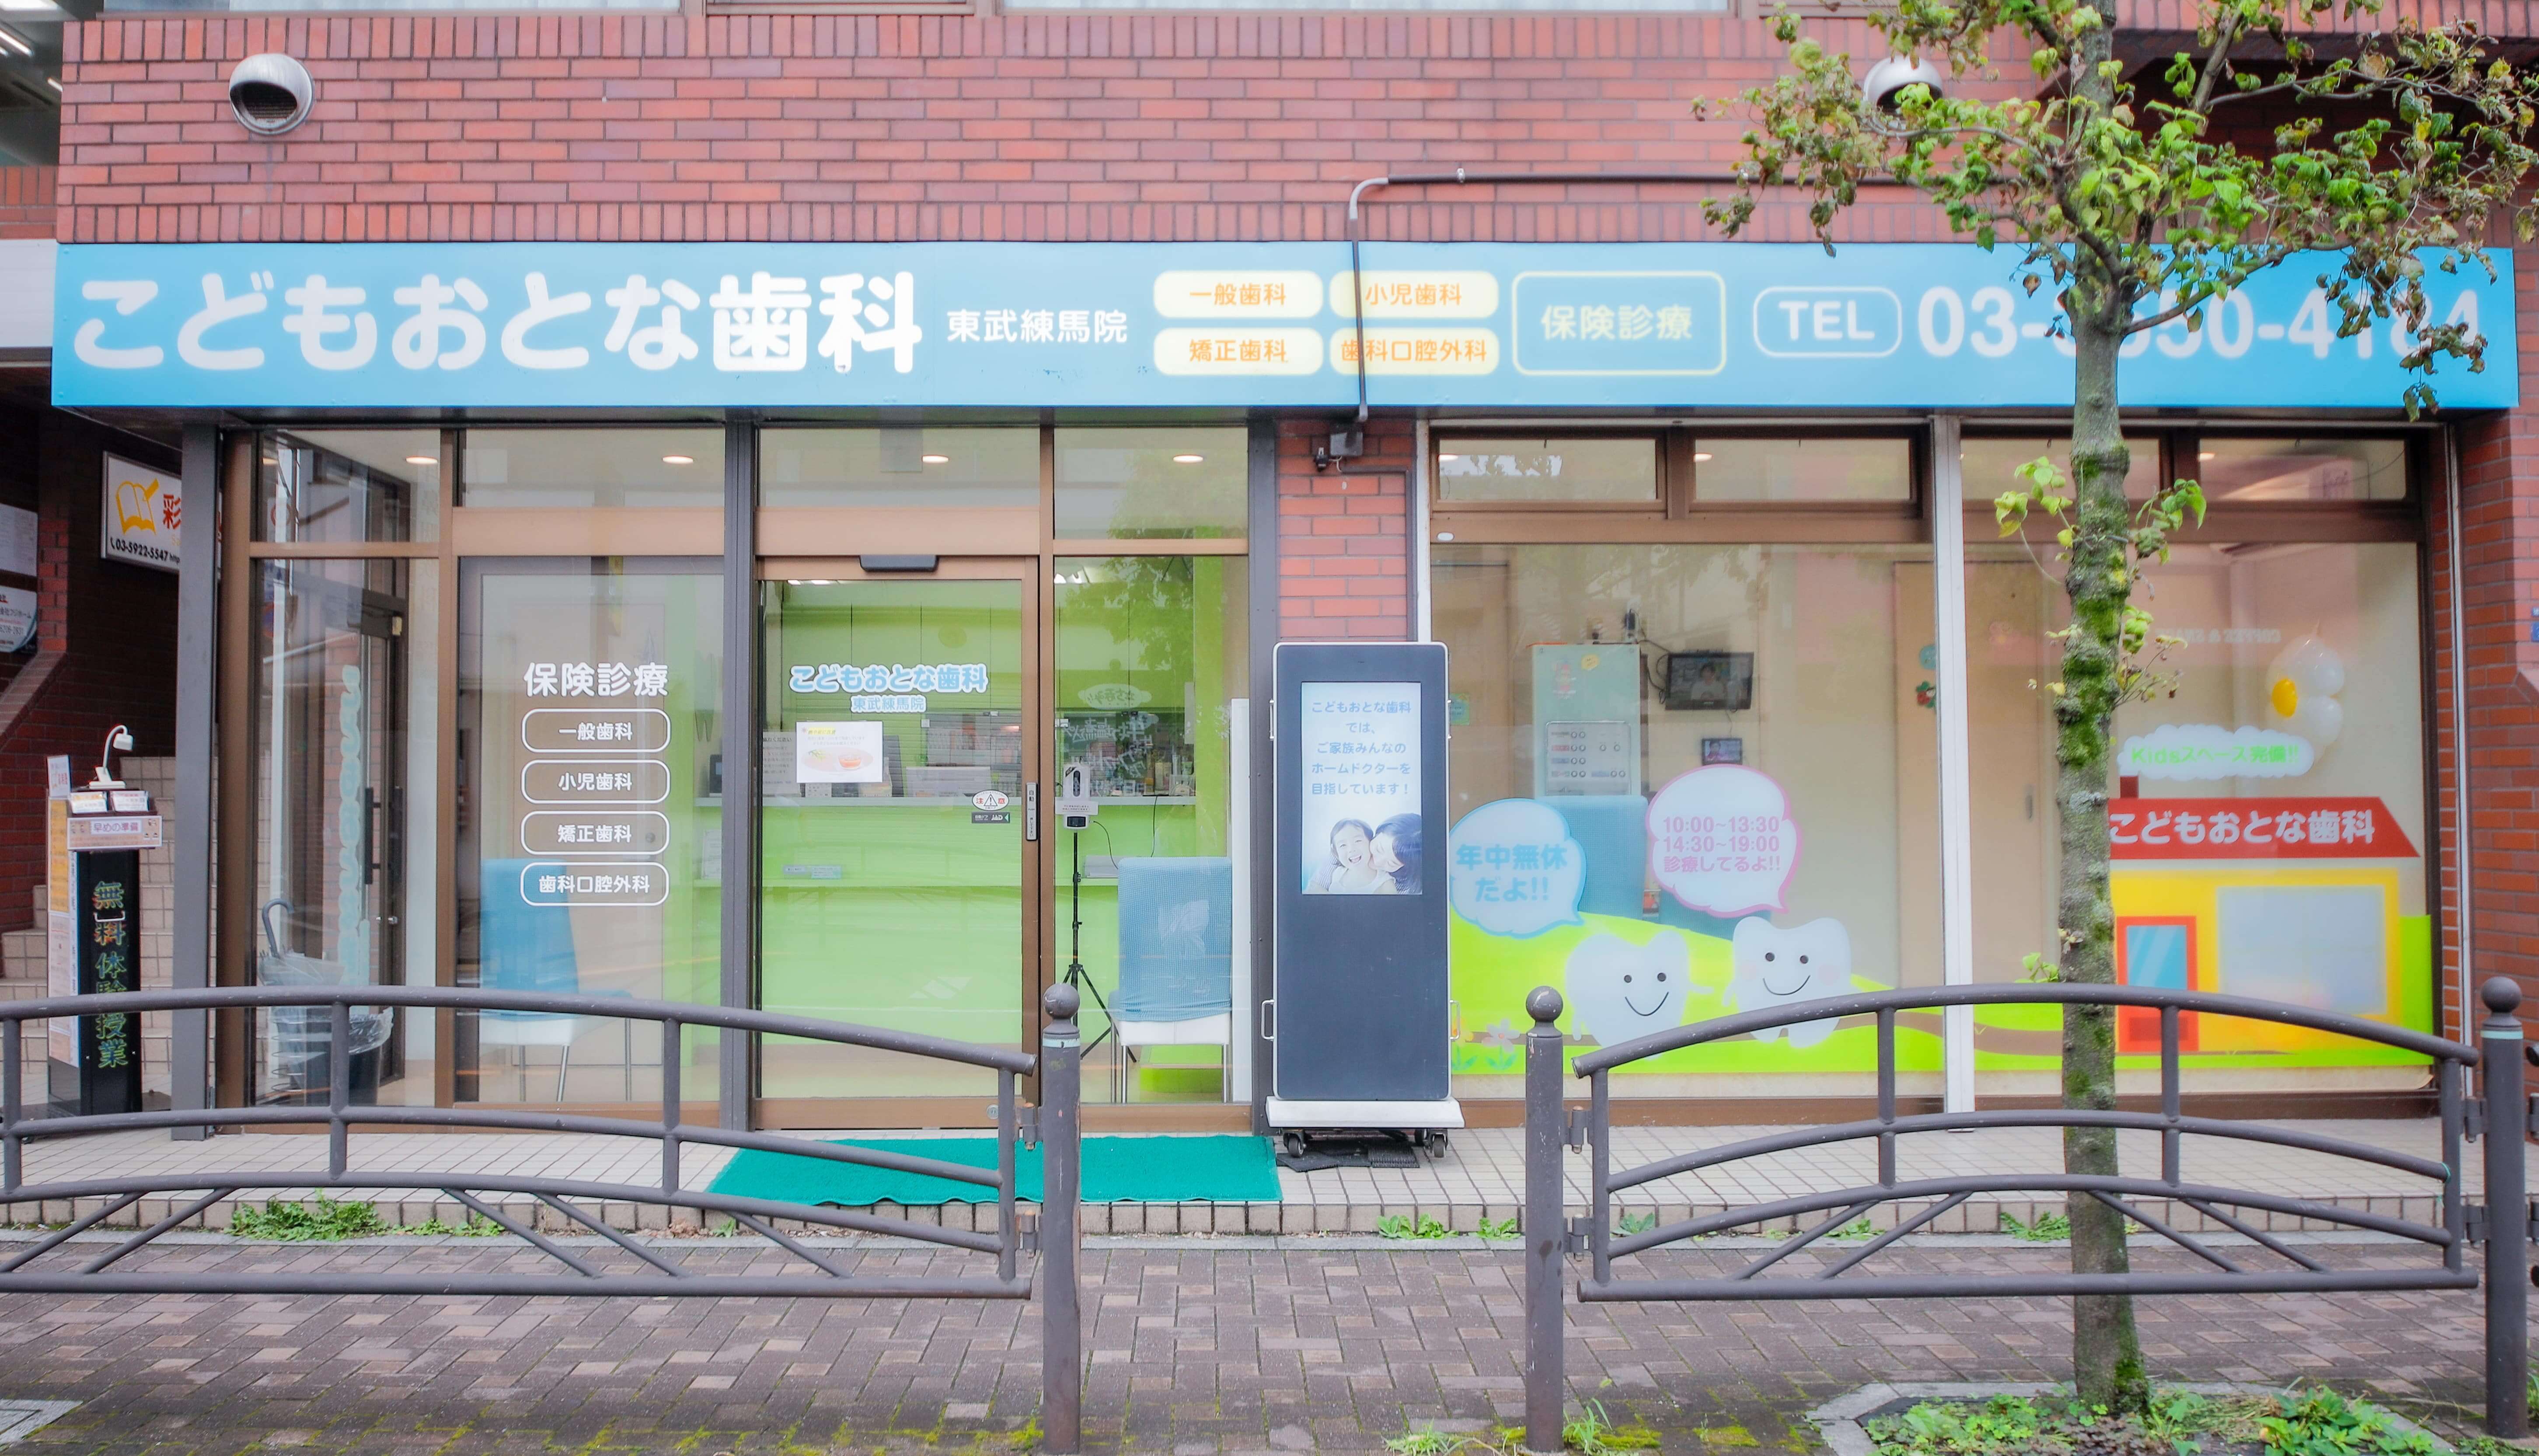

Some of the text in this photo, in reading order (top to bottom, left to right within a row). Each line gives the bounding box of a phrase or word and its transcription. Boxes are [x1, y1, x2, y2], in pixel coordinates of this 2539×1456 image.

[1189, 282, 1287, 306] 一般歯科
[1365, 282, 1461, 306] 小児歯科
[74, 270, 922, 373] こどもおとな歯科
[946, 309, 1128, 343] 東武練馬院
[1541, 304, 1693, 341] 保険診療
[1779, 300, 1875, 341] TEL
[1189, 338, 1287, 362] 矯正歯科
[1341, 339, 1487, 362] 歯科口腔外科
[115, 538, 168, 561] 03-5922-5547
[523, 662, 669, 697] 保険診療
[791, 665, 987, 691] こどもおとな歯科
[853, 696, 925, 711] 東武練馬院
[1312, 701, 1411, 713] こどもおとな歯科
[558, 722, 632, 740] 一般歯科
[1346, 721, 1375, 734] では、
[1316, 742, 1406, 754] ご家族みんなの
[1311, 763, 1411, 775] ホームドクターを
[558, 773, 632, 791] 小児歯科
[1312, 783, 1409, 795] 目指しています！
[94, 822, 139, 832] 早めの準備
[558, 824, 631, 843] 矯正歯科
[2109, 810, 2375, 844] こどもおとな歯科
[1456, 843, 1568, 871] 年中無休
[538, 875, 650, 894] 歯科口腔外科
